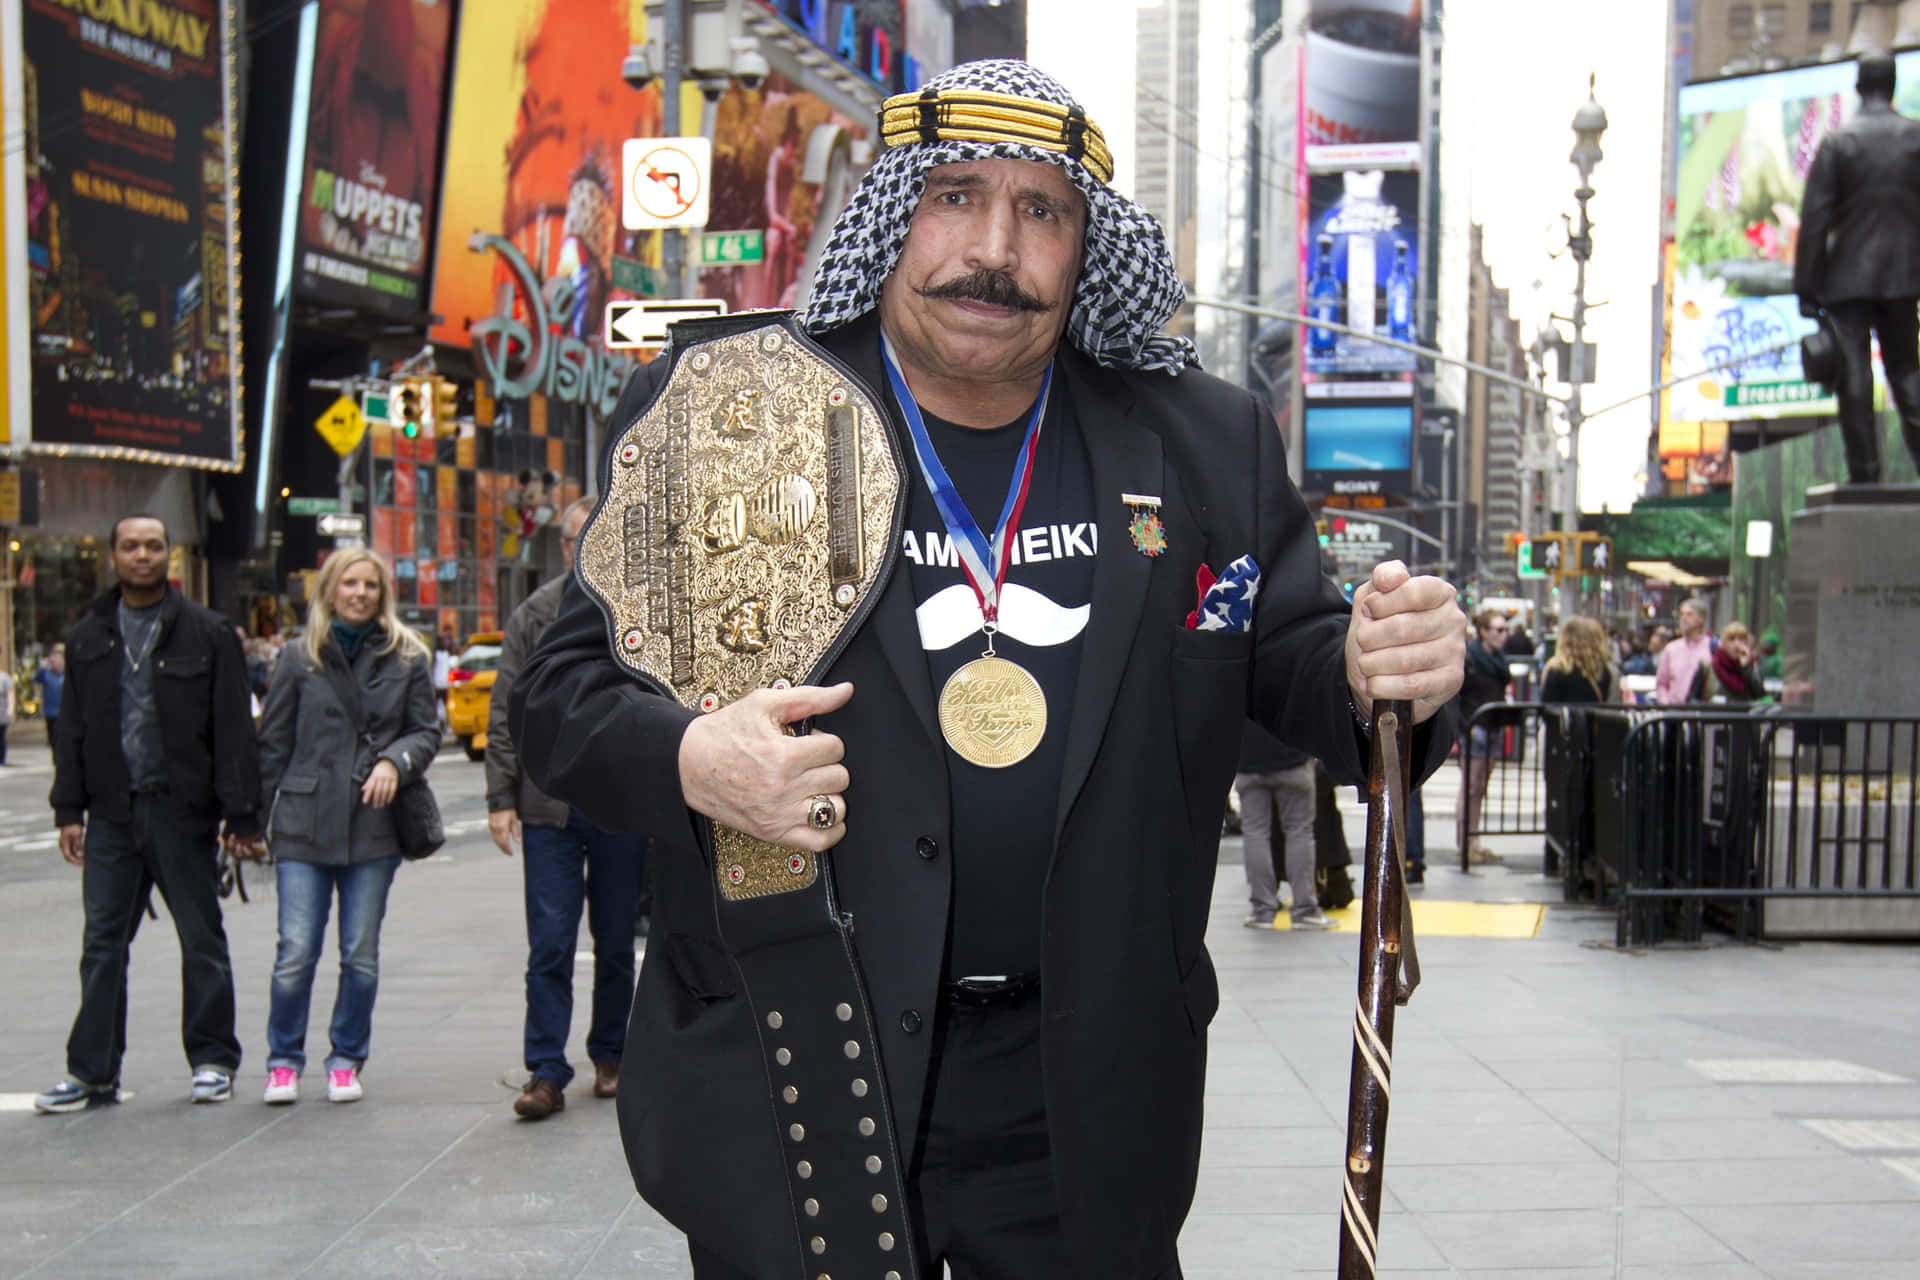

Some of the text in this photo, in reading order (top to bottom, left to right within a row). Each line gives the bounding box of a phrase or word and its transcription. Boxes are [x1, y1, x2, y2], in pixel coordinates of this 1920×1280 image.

[109, 28, 174, 72] MUSICAL
[311, 168, 422, 239] MUPPETS
[705, 239, 719, 260] W
[720, 235, 742, 260] 46
[1738, 383, 1821, 405] Broadway
[829, 432, 848, 558] THE IRON SHEIK
[1333, 481, 1380, 493] SONY
[626, 504, 647, 585] WORLD
[648, 450, 668, 628] HEAVYWEIGHT
[669, 393, 692, 684] WRESTLING CHAMPION
